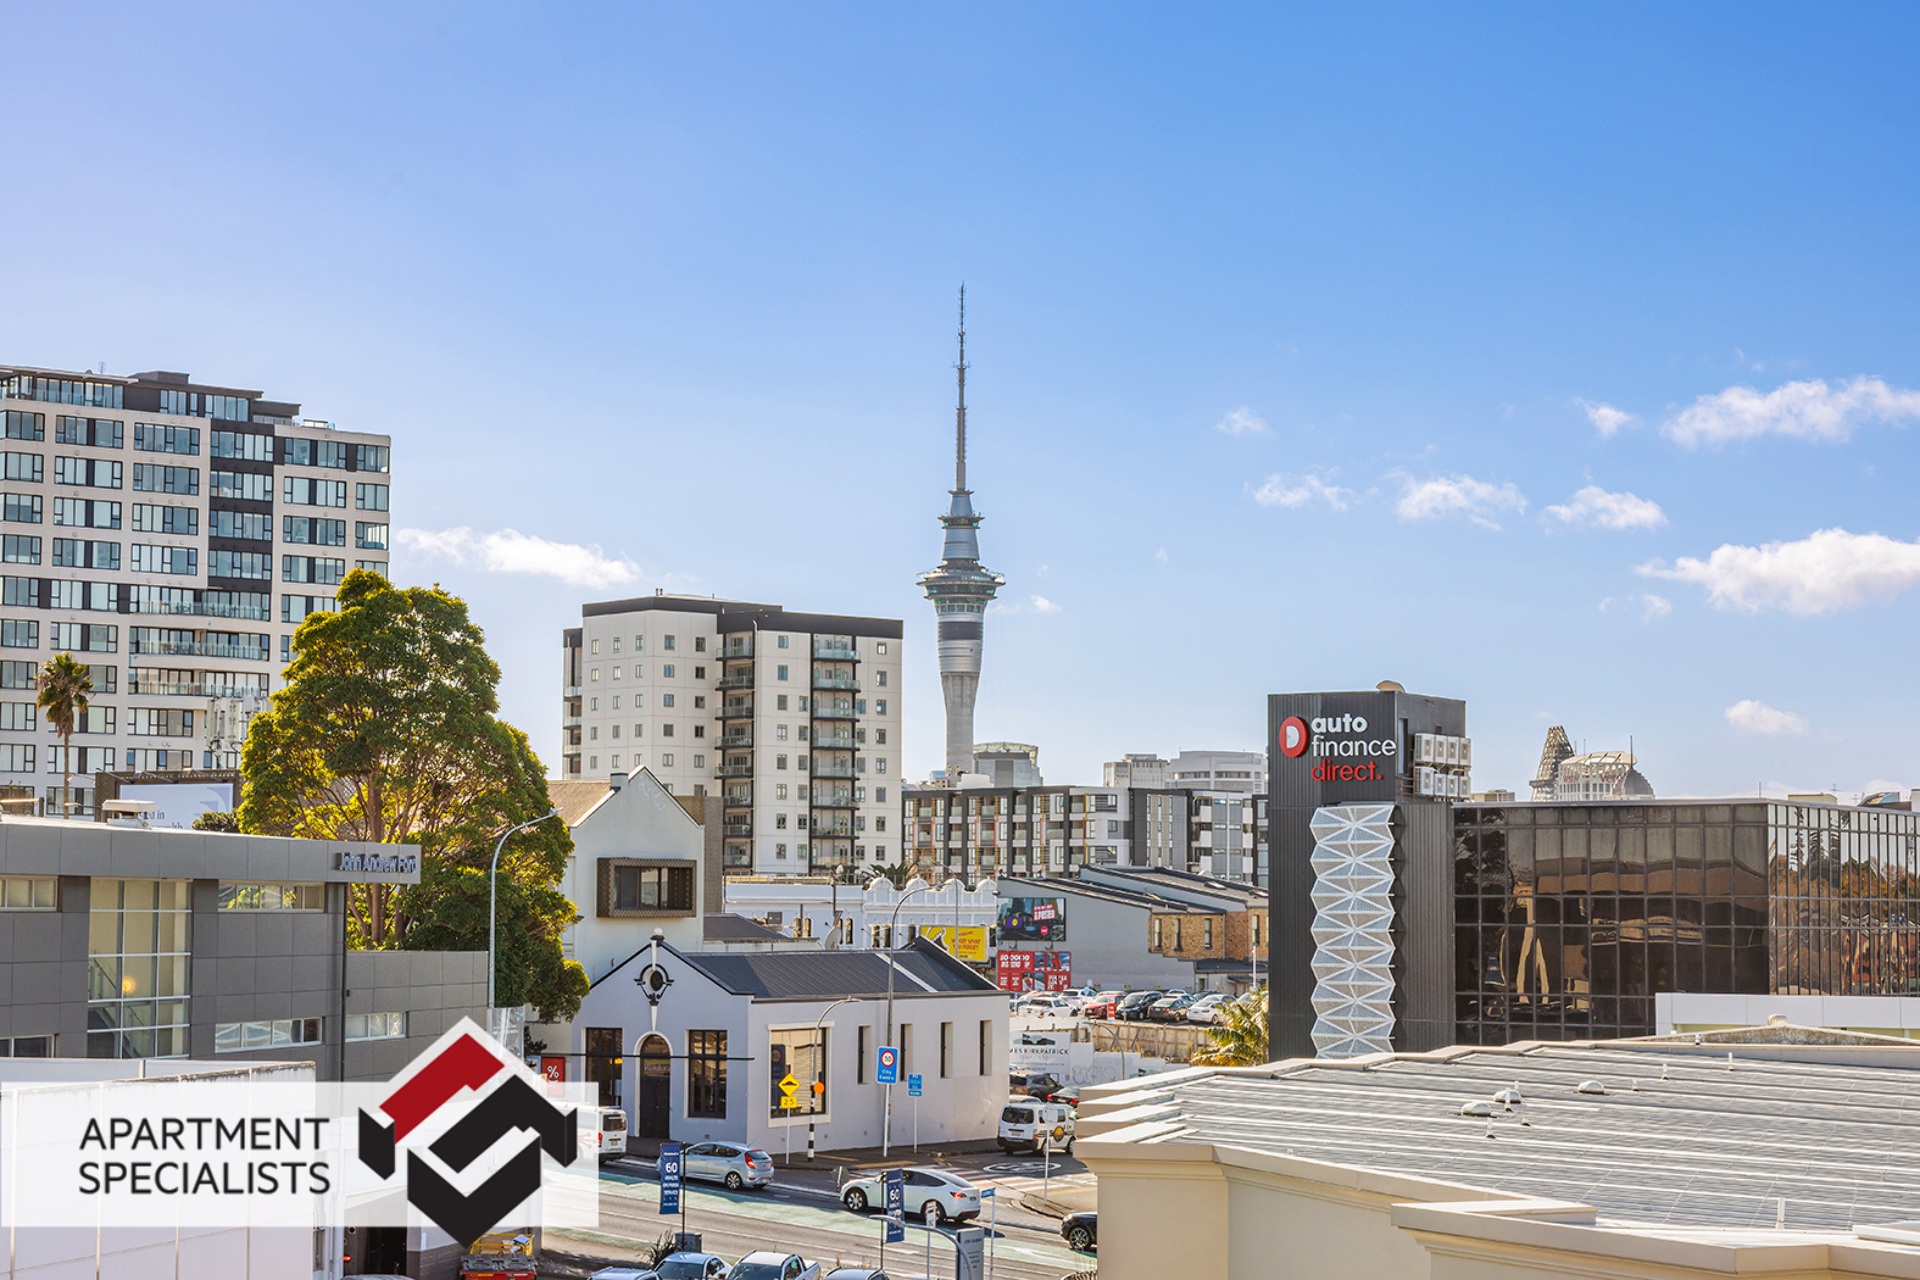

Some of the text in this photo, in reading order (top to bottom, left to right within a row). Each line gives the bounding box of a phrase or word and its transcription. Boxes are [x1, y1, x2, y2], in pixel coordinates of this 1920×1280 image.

[1311, 713, 1368, 733] auto
[1311, 735, 1396, 757] finance
[1311, 759, 1384, 780] direct.
[340, 852, 418, 873] John Andrew Ford
[665, 1162, 678, 1173] 60
